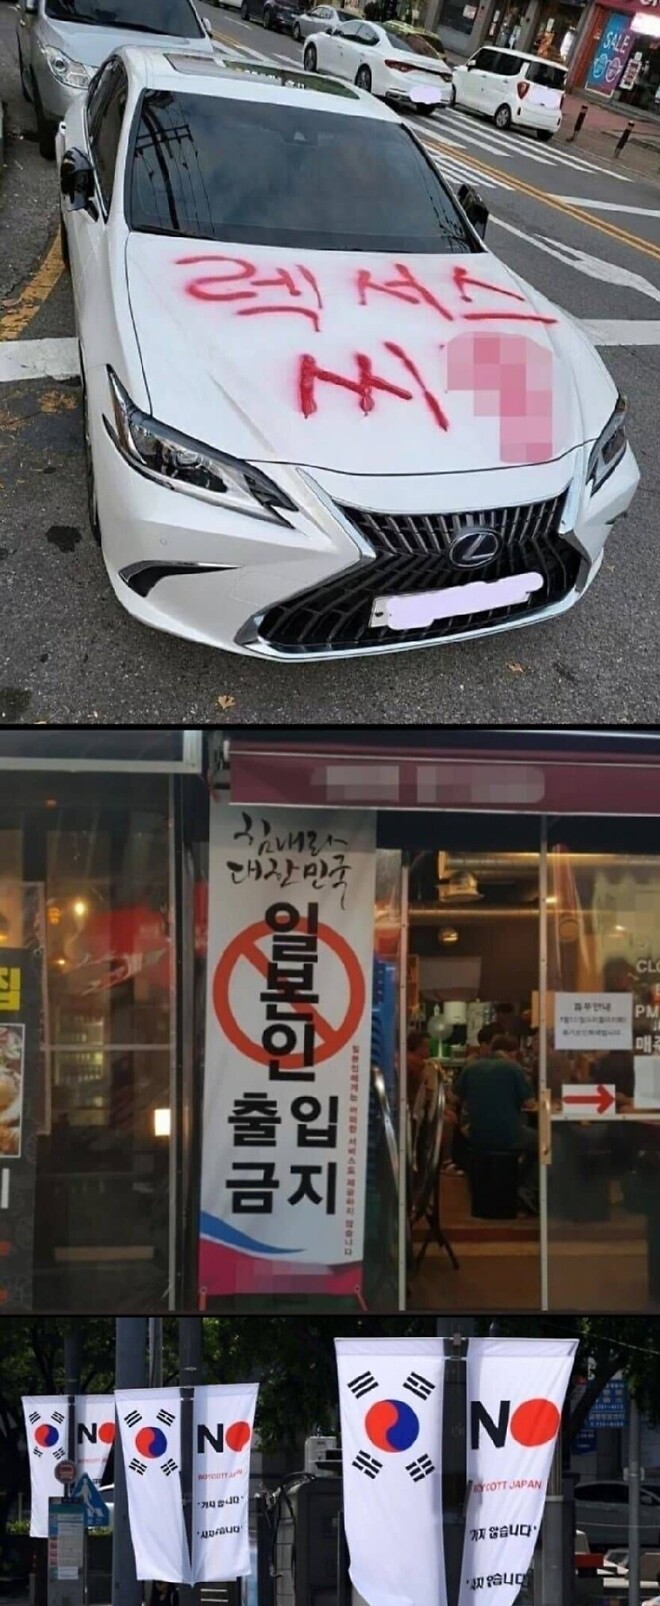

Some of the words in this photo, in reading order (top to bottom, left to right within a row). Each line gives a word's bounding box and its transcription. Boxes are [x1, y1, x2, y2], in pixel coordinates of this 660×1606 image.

[603, 31, 630, 53] SALE
[175, 254, 559, 332] 렉서스
[226, 855, 351, 910] 대한민국
[260, 902, 319, 1082] 일본인
[228, 1092, 339, 1148] 출입
[226, 1162, 337, 1214] 금지
[78, 1422, 116, 1444] NO
[197, 1421, 251, 1453] NO
[471, 1398, 561, 1450] NO
[509, 1480, 542, 1490] JAPAN
